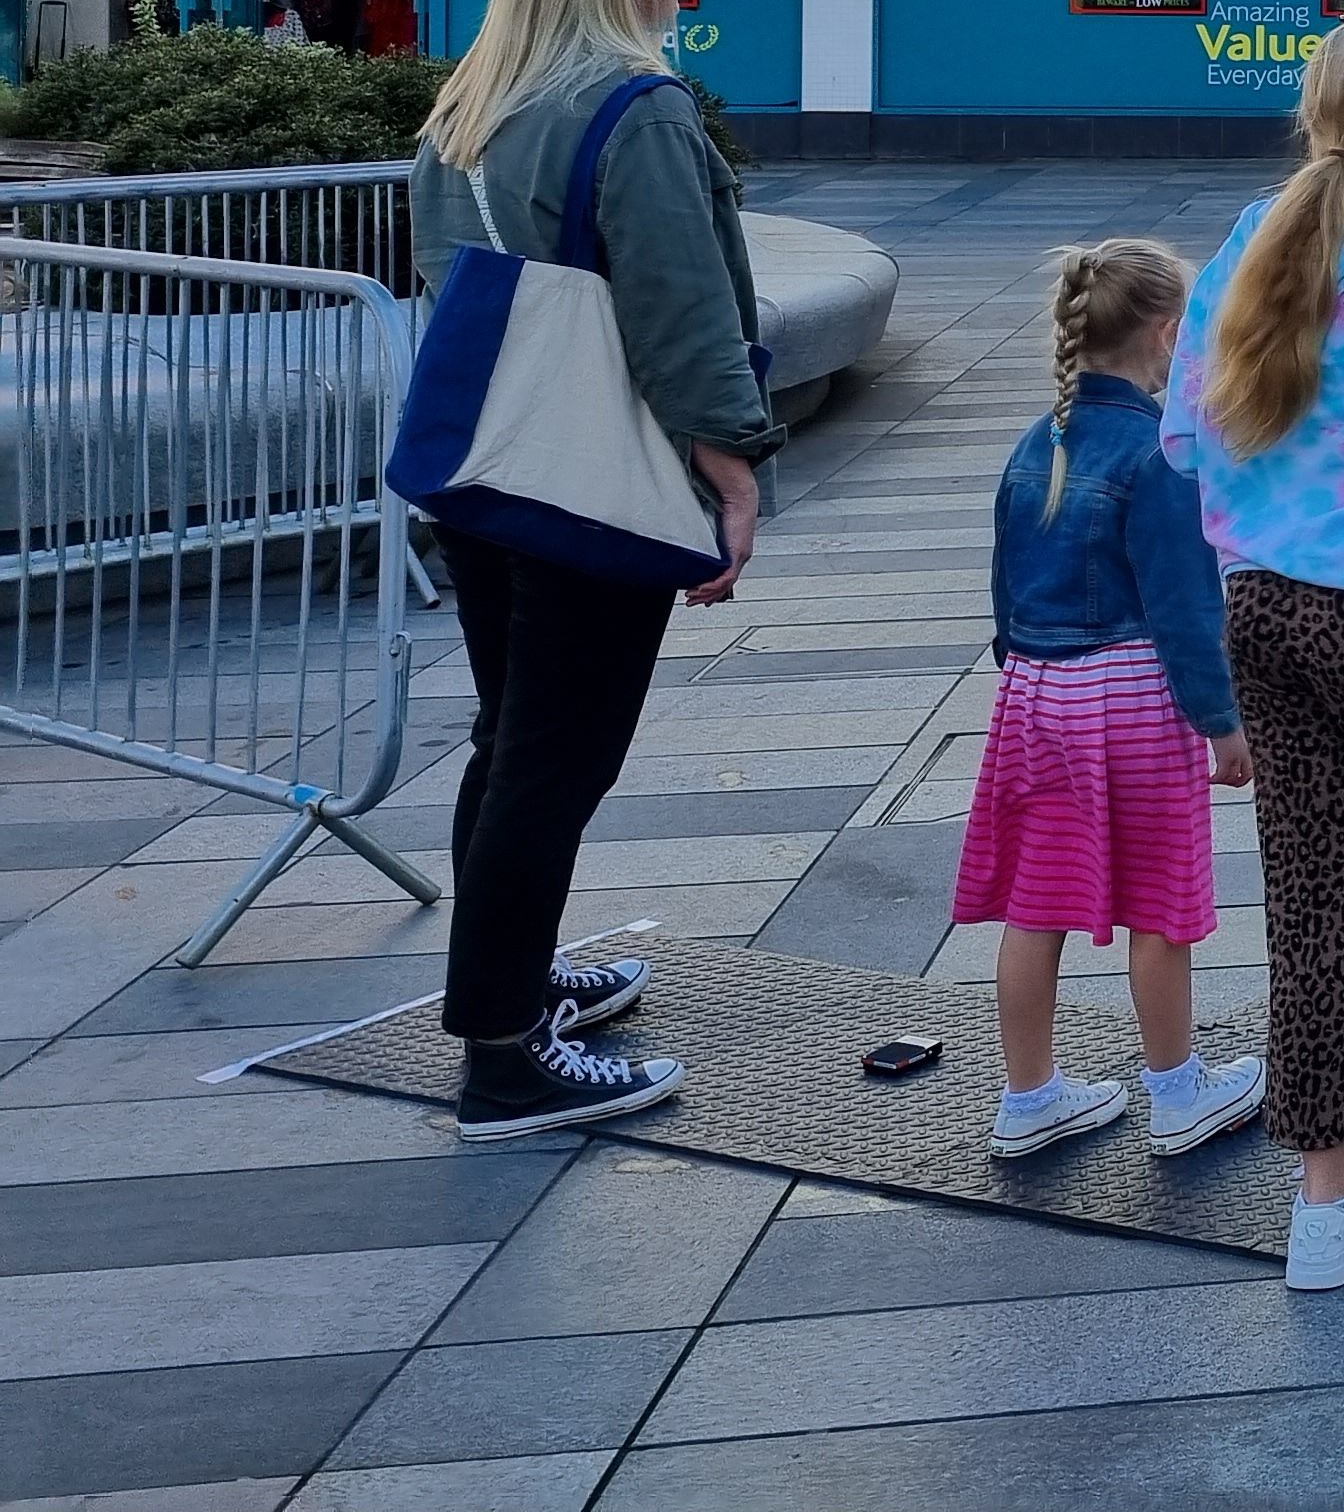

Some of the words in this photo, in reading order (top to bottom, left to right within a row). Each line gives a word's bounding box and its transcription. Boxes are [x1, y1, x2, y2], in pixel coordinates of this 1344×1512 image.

[1210, 0, 1310, 28] Amazing
[1195, 23, 1324, 62] Value
[1207, 63, 1306, 91] Everyday
